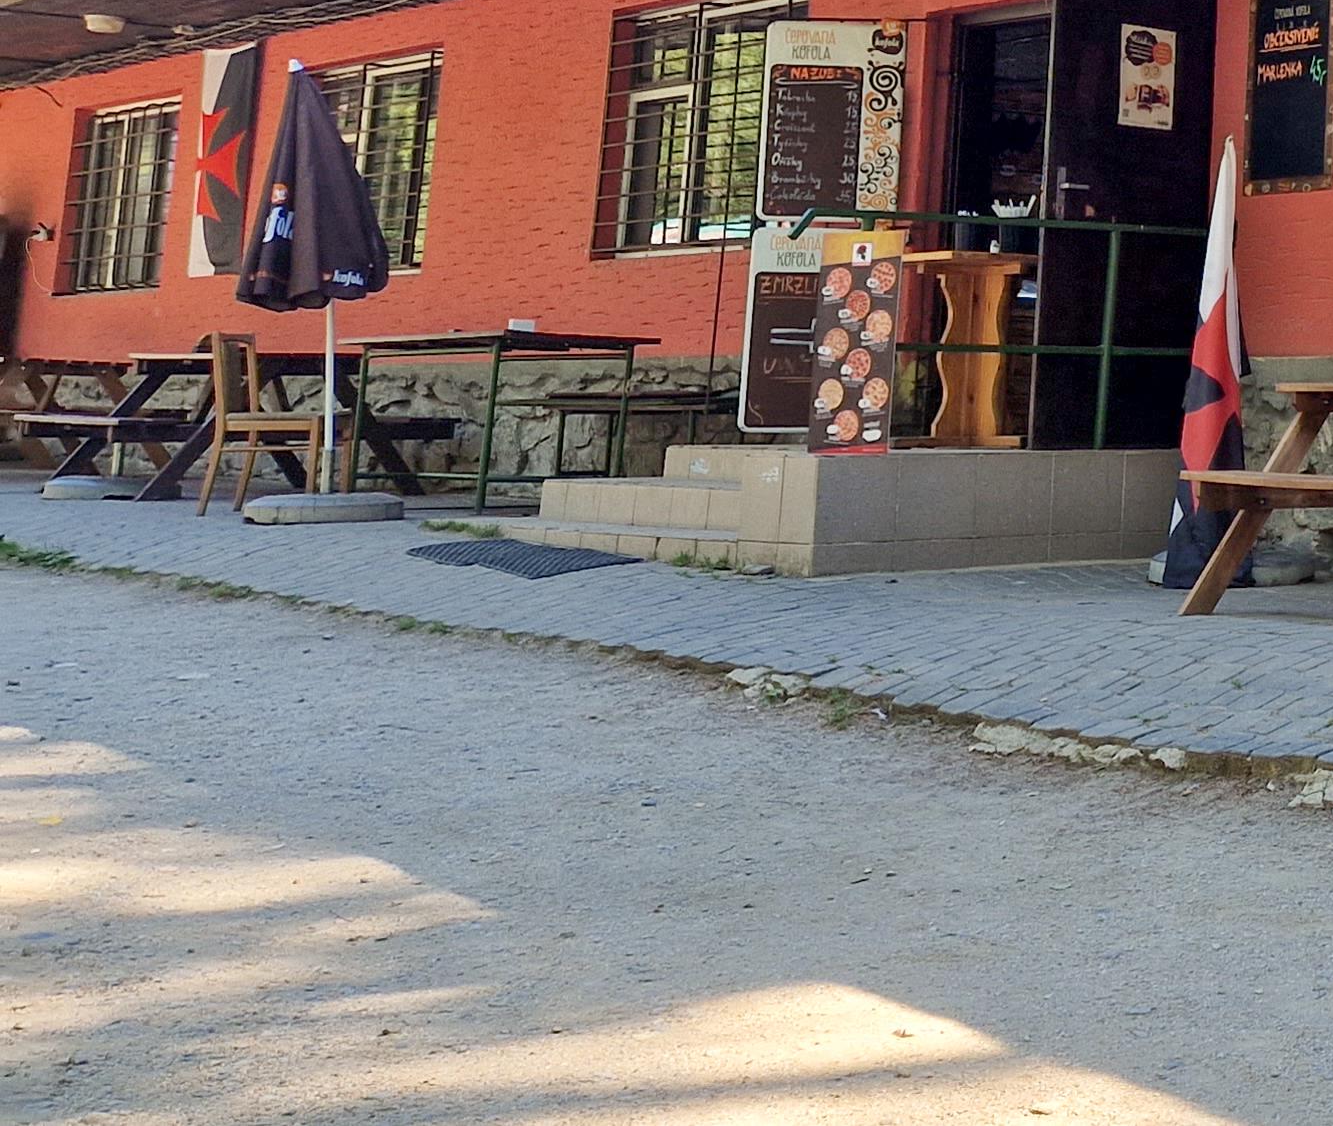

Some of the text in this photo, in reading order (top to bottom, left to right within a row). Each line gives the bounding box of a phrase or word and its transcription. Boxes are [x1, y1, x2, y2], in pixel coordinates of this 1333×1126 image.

[791, 45, 831, 61] KOFOLA
[1257, 60, 1303, 86] MARLENKA
[777, 251, 816, 267] KOFOLA
[332, 269, 364, 287] kofola
[760, 274, 817, 294] ZMRZLI
